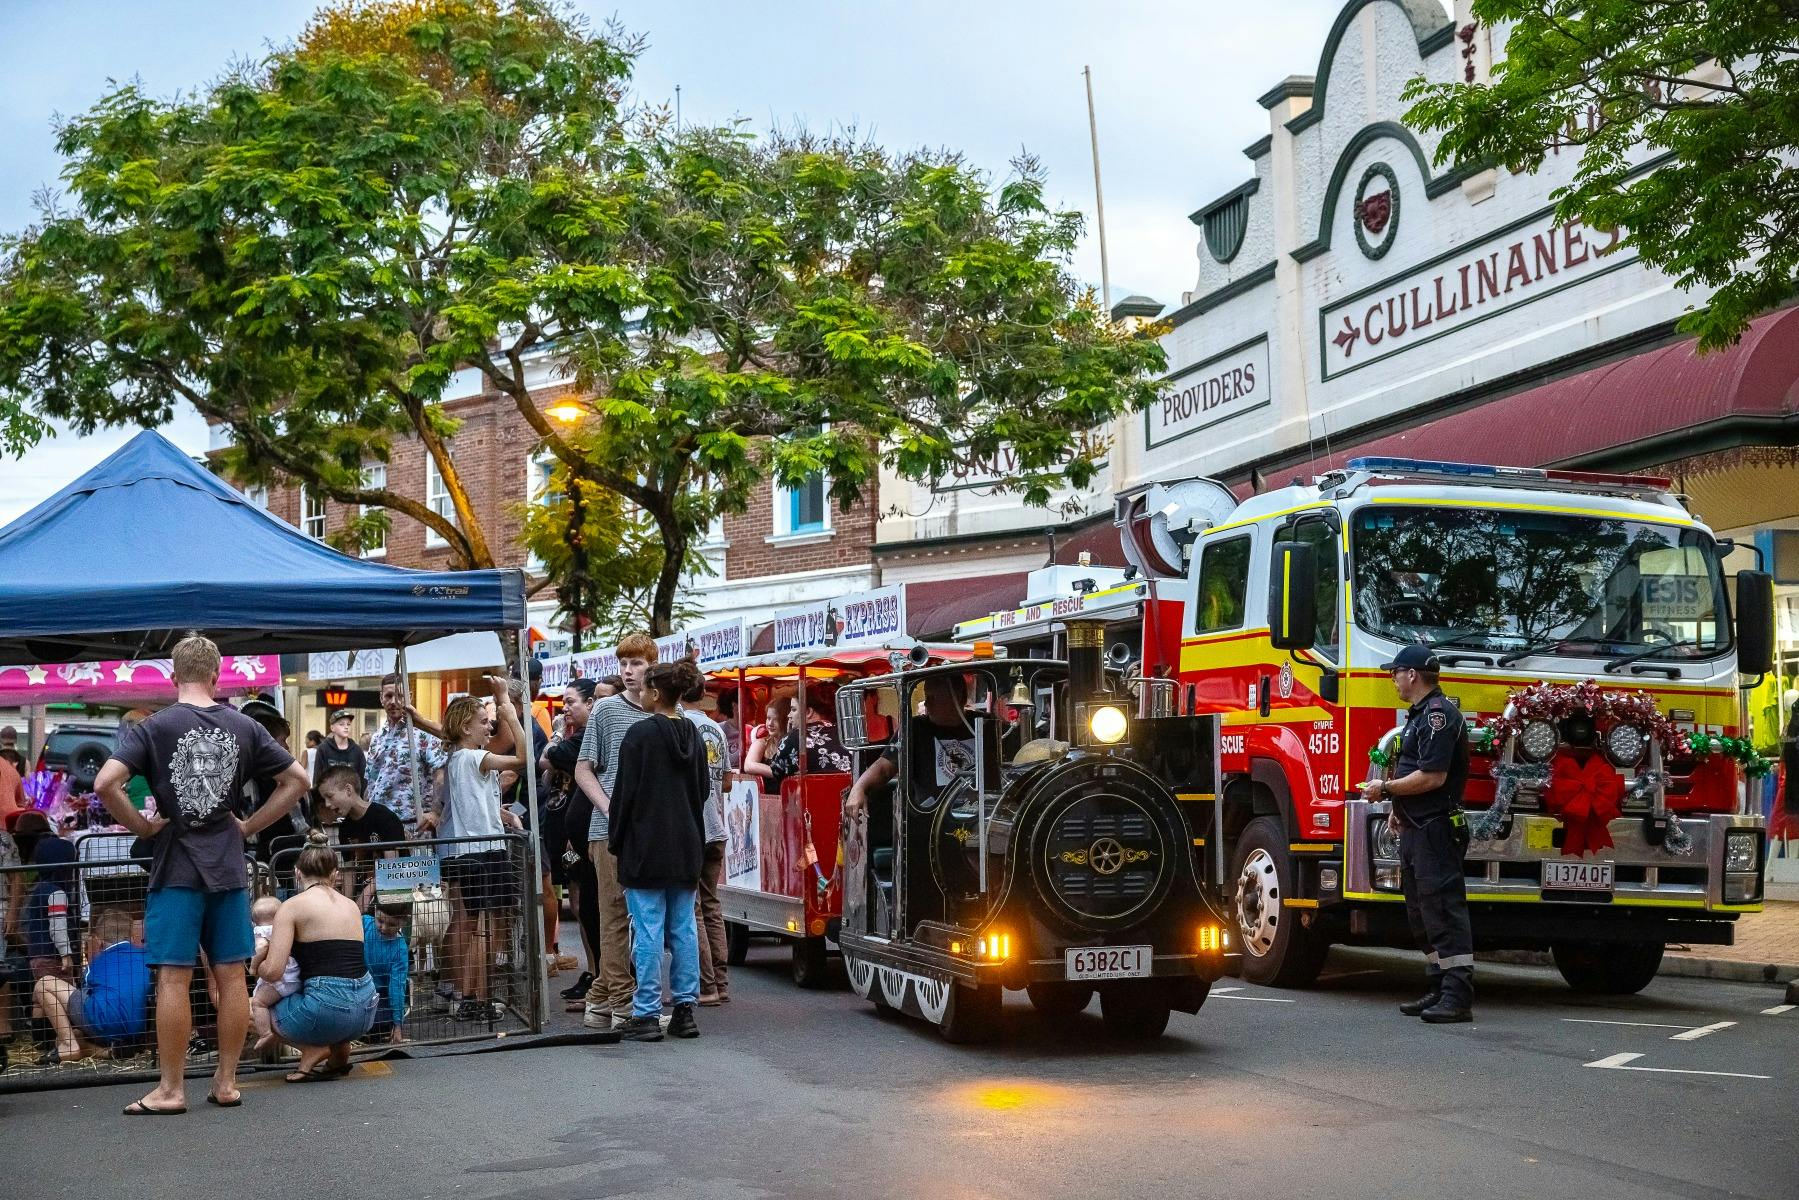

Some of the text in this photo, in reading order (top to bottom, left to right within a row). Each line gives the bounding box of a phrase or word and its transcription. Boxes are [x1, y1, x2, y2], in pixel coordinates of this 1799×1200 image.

[1364, 217, 1619, 345] CULLINANES
[1162, 363, 1255, 426] PROVIDERS
[1645, 579, 1698, 603] ESIS
[776, 615, 807, 650] DINKY
[845, 595, 898, 639] EXPRESS
[1000, 596, 1085, 627] FIRE AND RESCUE
[701, 626, 740, 663] EXPRESS
[1313, 720, 1334, 730] GYMPIE
[1221, 735, 1245, 753] SCUE
[1308, 733, 1340, 754] 451B
[1319, 774, 1339, 794] 1374
[378, 861, 407, 870] PLEASE
[387, 872, 405, 880] PICK
[406, 871, 417, 879] US
